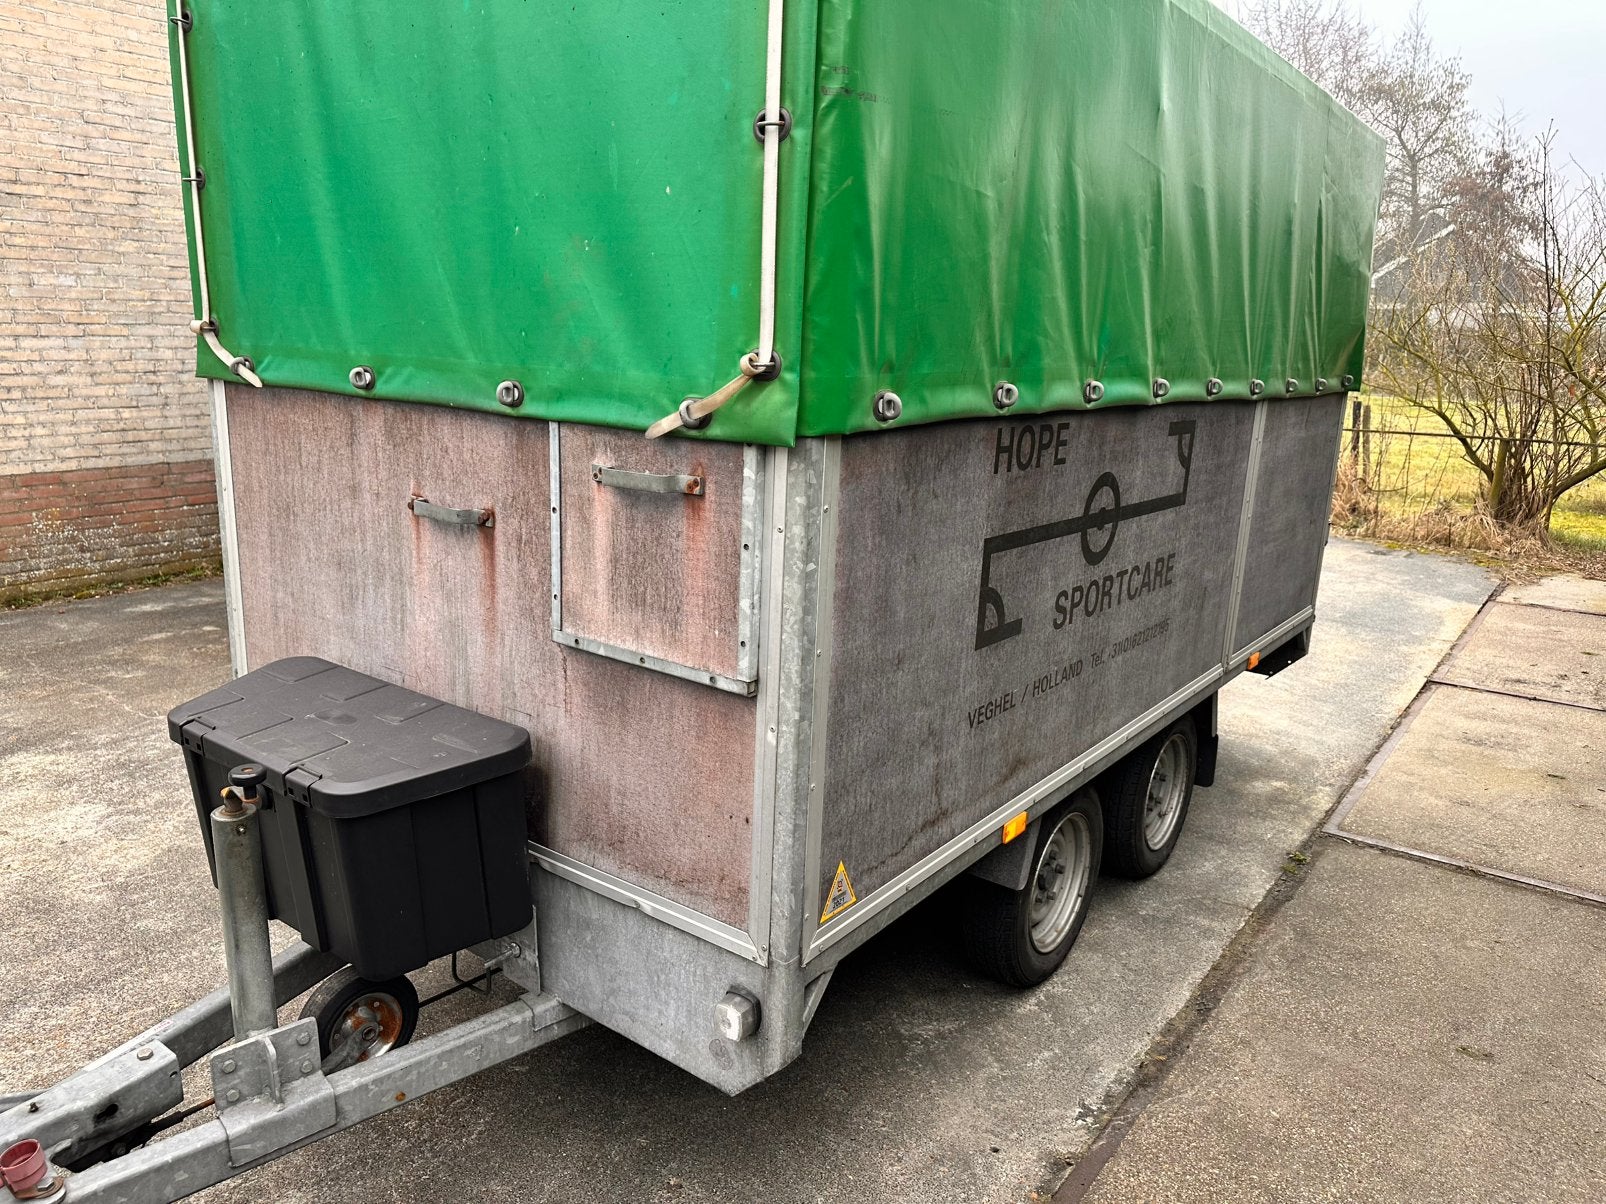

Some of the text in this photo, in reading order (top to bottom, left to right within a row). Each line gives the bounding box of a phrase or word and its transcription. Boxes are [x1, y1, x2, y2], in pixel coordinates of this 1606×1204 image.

[993, 422, 1071, 474] HOPE
[1052, 552, 1176, 630] SPORTCARE
[968, 691, 1016, 729] VEGHEL
[1032, 659, 1083, 698] HOLLAND
